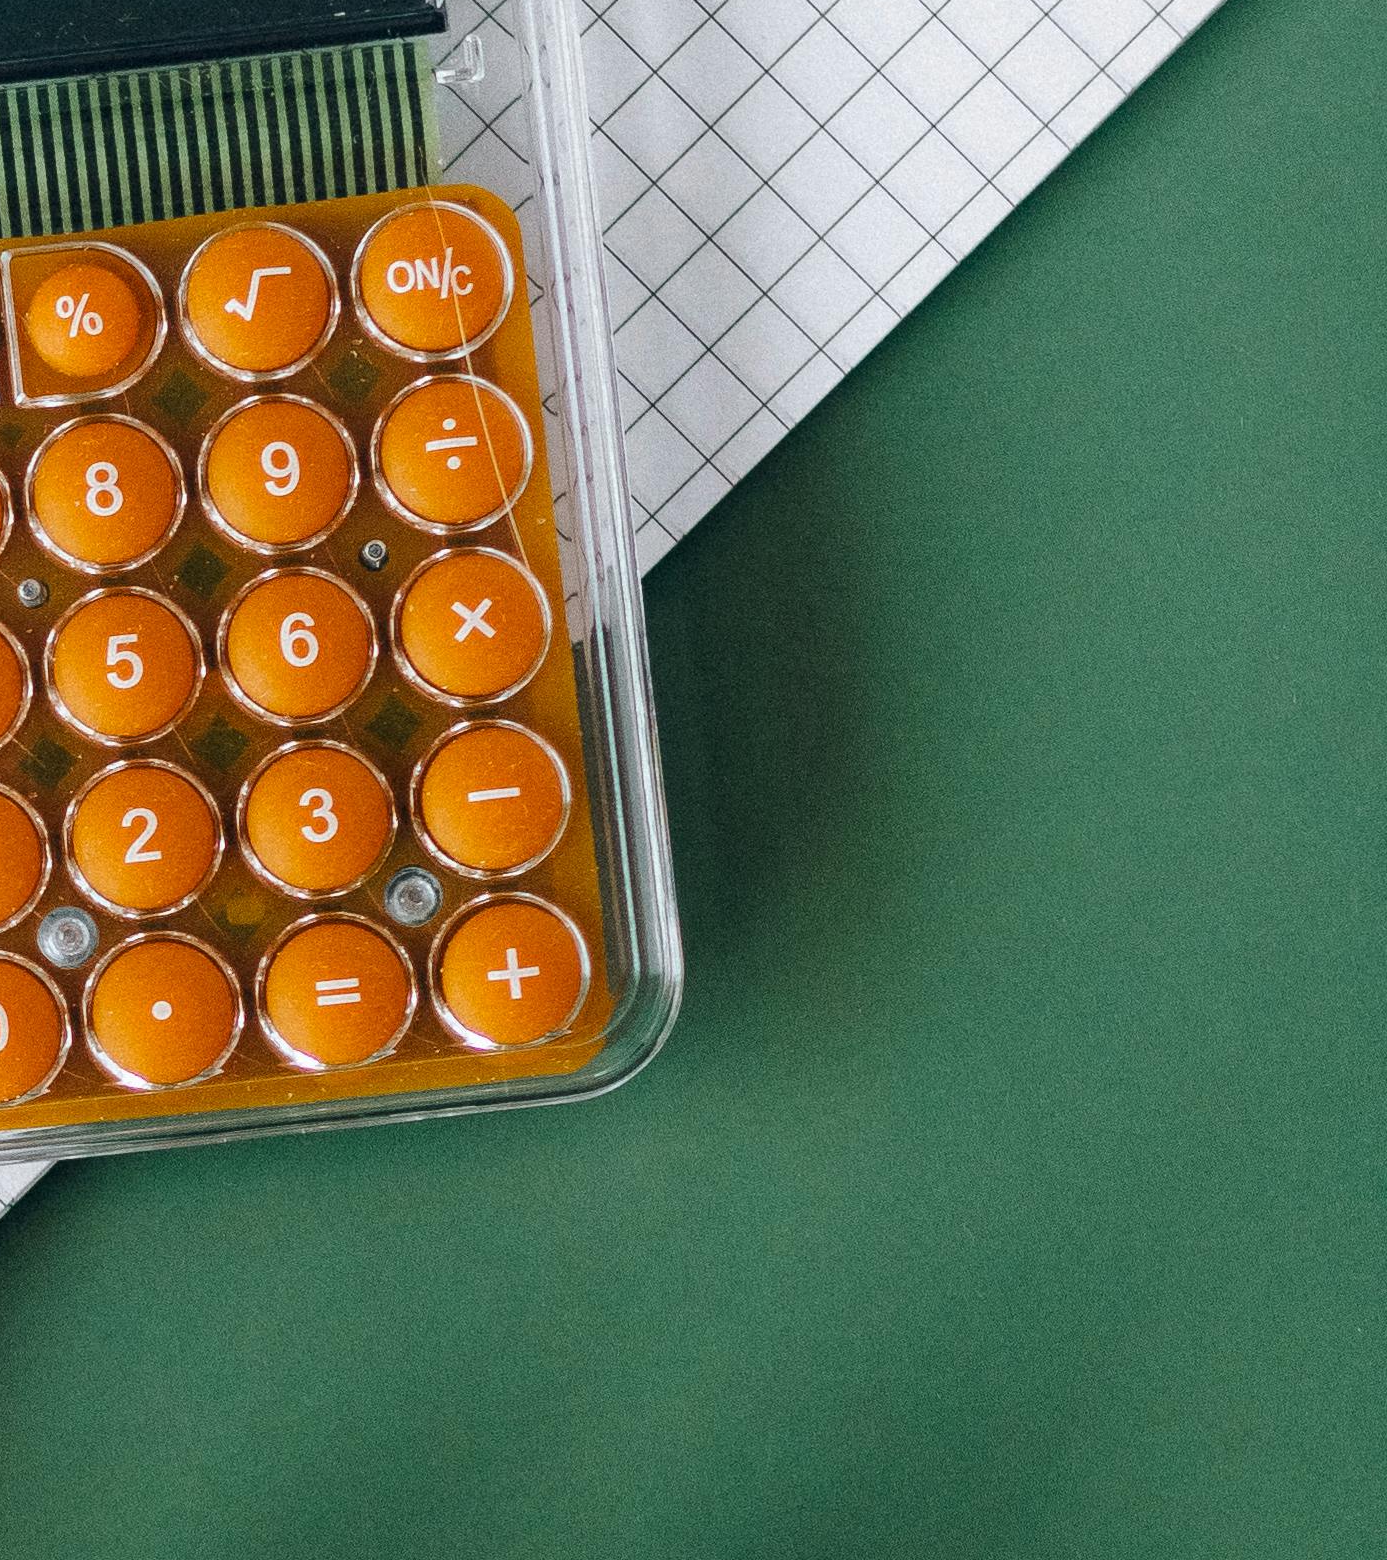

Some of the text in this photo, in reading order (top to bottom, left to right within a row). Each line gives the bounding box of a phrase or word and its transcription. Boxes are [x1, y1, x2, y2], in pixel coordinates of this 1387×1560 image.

[54, 292, 104, 339] %
[385, 247, 474, 300] ON/C
[84, 460, 124, 518] 8
[259, 440, 301, 497] 9
[105, 633, 144, 690] 5
[279, 611, 320, 668] 6
[120, 807, 163, 865] 2
[298, 787, 339, 844] 3
[486, 947, 540, 1000] +
